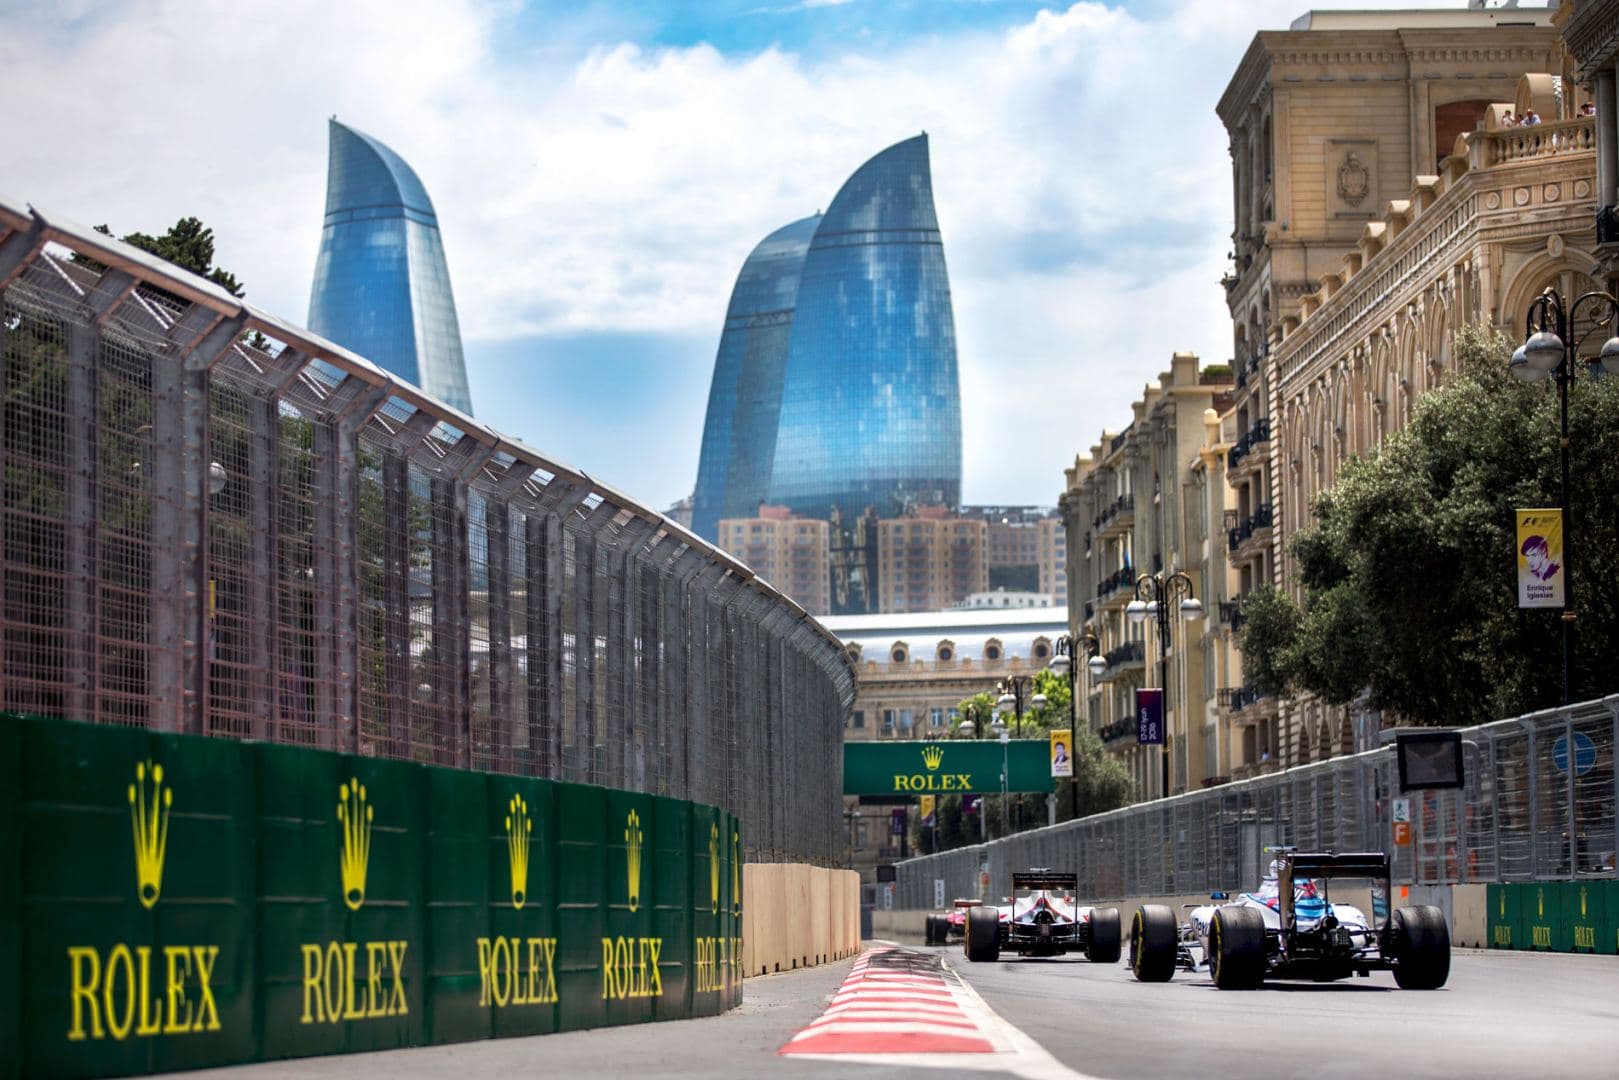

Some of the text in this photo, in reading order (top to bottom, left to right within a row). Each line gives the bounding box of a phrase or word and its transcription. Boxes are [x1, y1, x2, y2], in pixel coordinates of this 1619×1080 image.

[1527, 584, 1553, 592] Enrique
[1527, 592, 1553, 600] Iglesias
[894, 774, 973, 791] ROLEX
[1395, 824, 1407, 843] F
[1532, 926, 1551, 947] ROLEX
[1574, 926, 1595, 948] ROLEX
[476, 935, 559, 1009] ROLEX
[601, 936, 664, 1001] ROLEX
[67, 943, 222, 1041] ROLEX
[300, 940, 409, 1025] ROLEX
